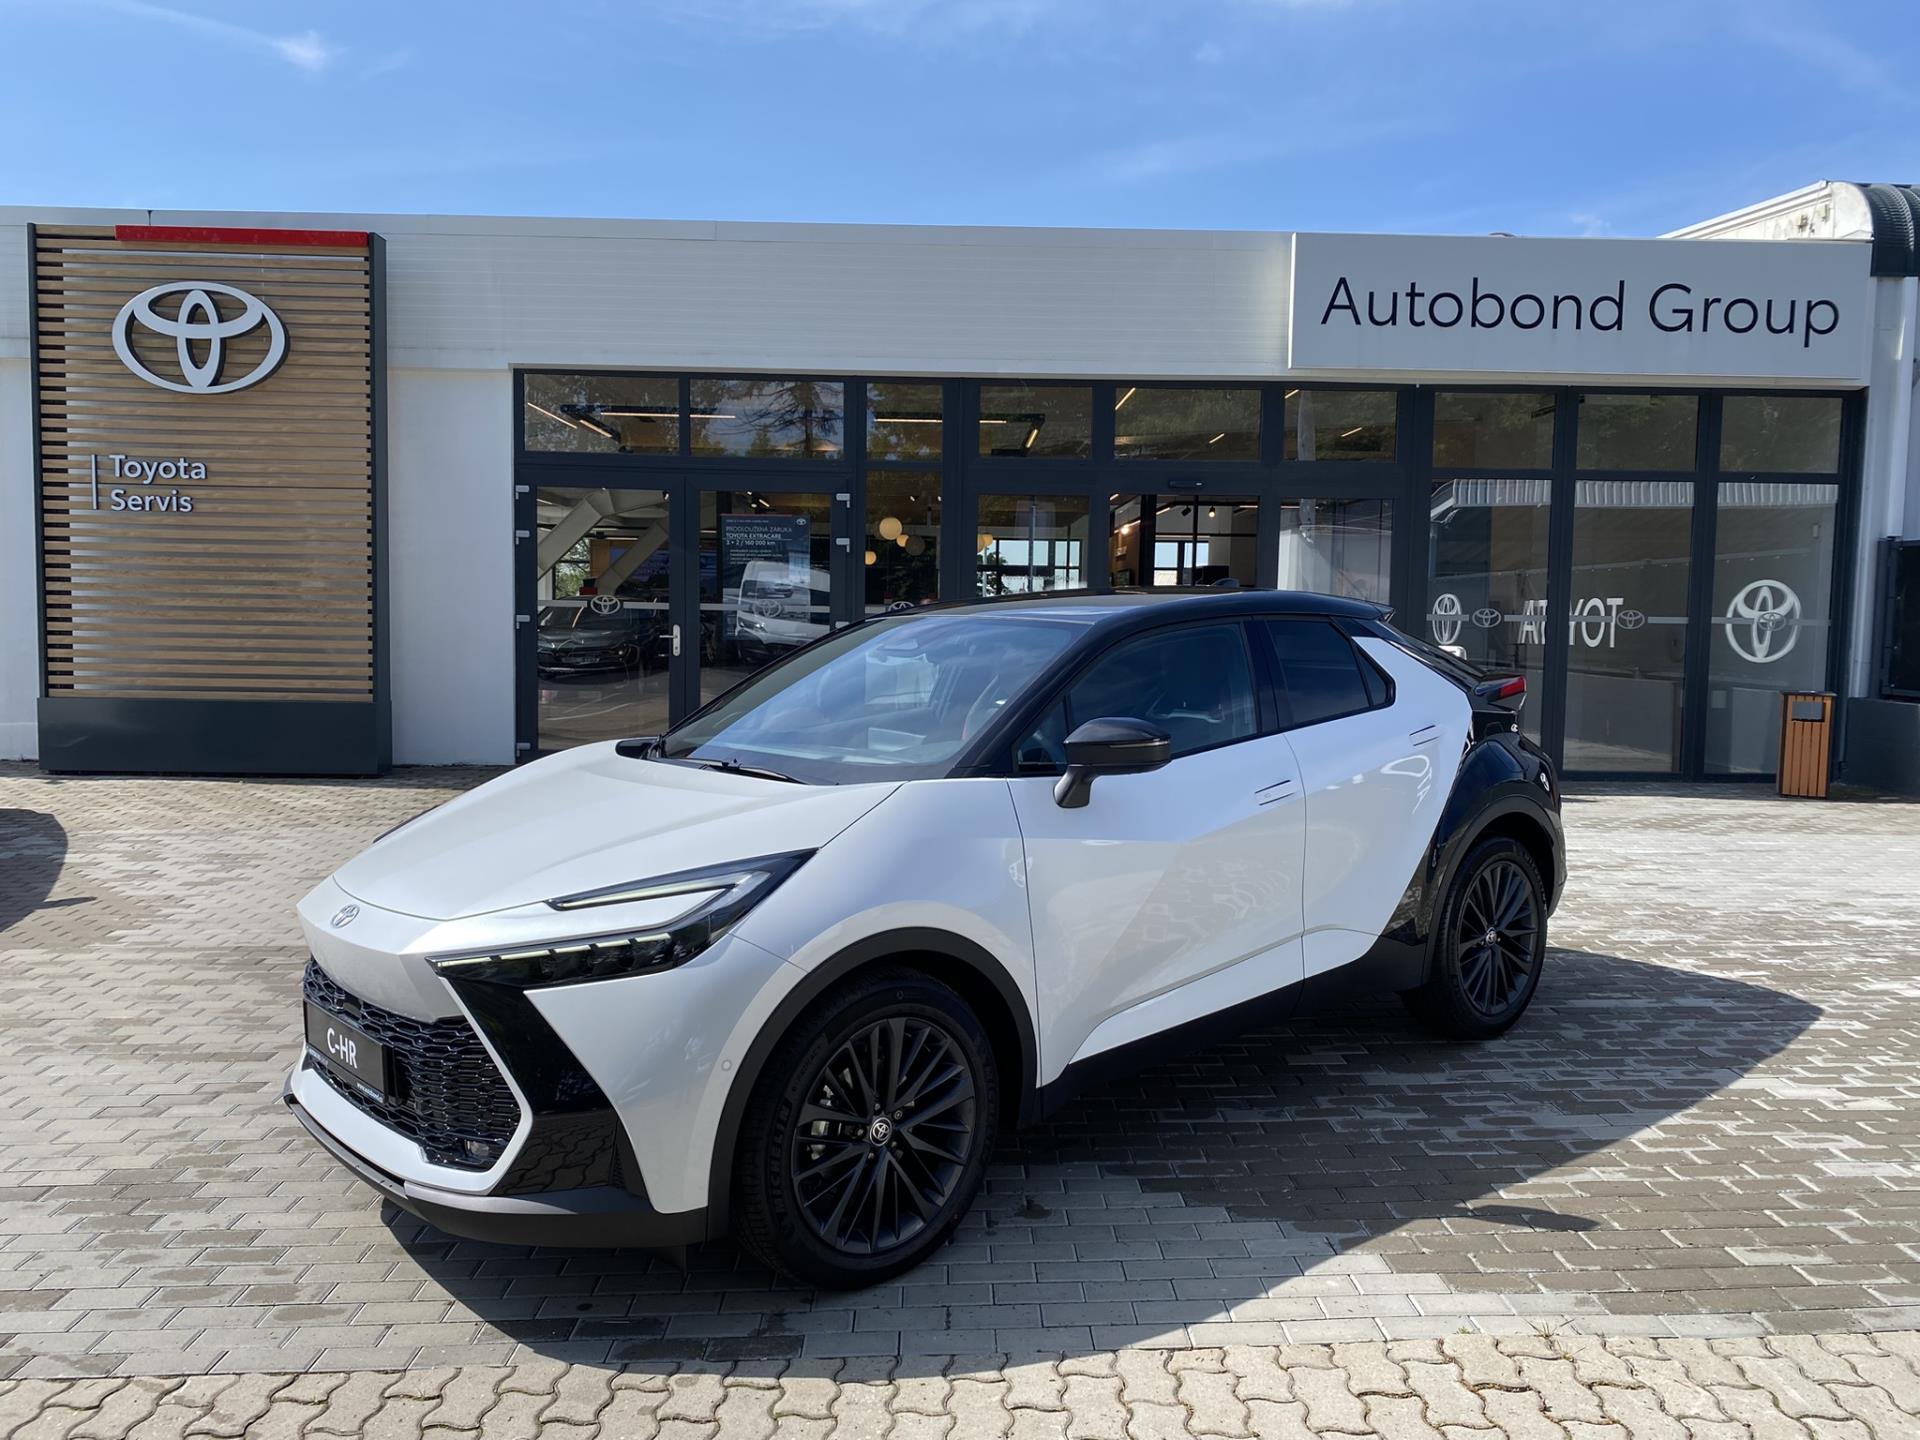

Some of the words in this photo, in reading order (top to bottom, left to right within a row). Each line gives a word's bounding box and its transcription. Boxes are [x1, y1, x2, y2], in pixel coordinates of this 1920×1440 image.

[1321, 276, 1625, 332] Autobond
[1648, 283, 1840, 347] Group
[109, 454, 207, 485] Toyota
[110, 489, 192, 512] Servis
[327, 1027, 358, 1069] C-HR
